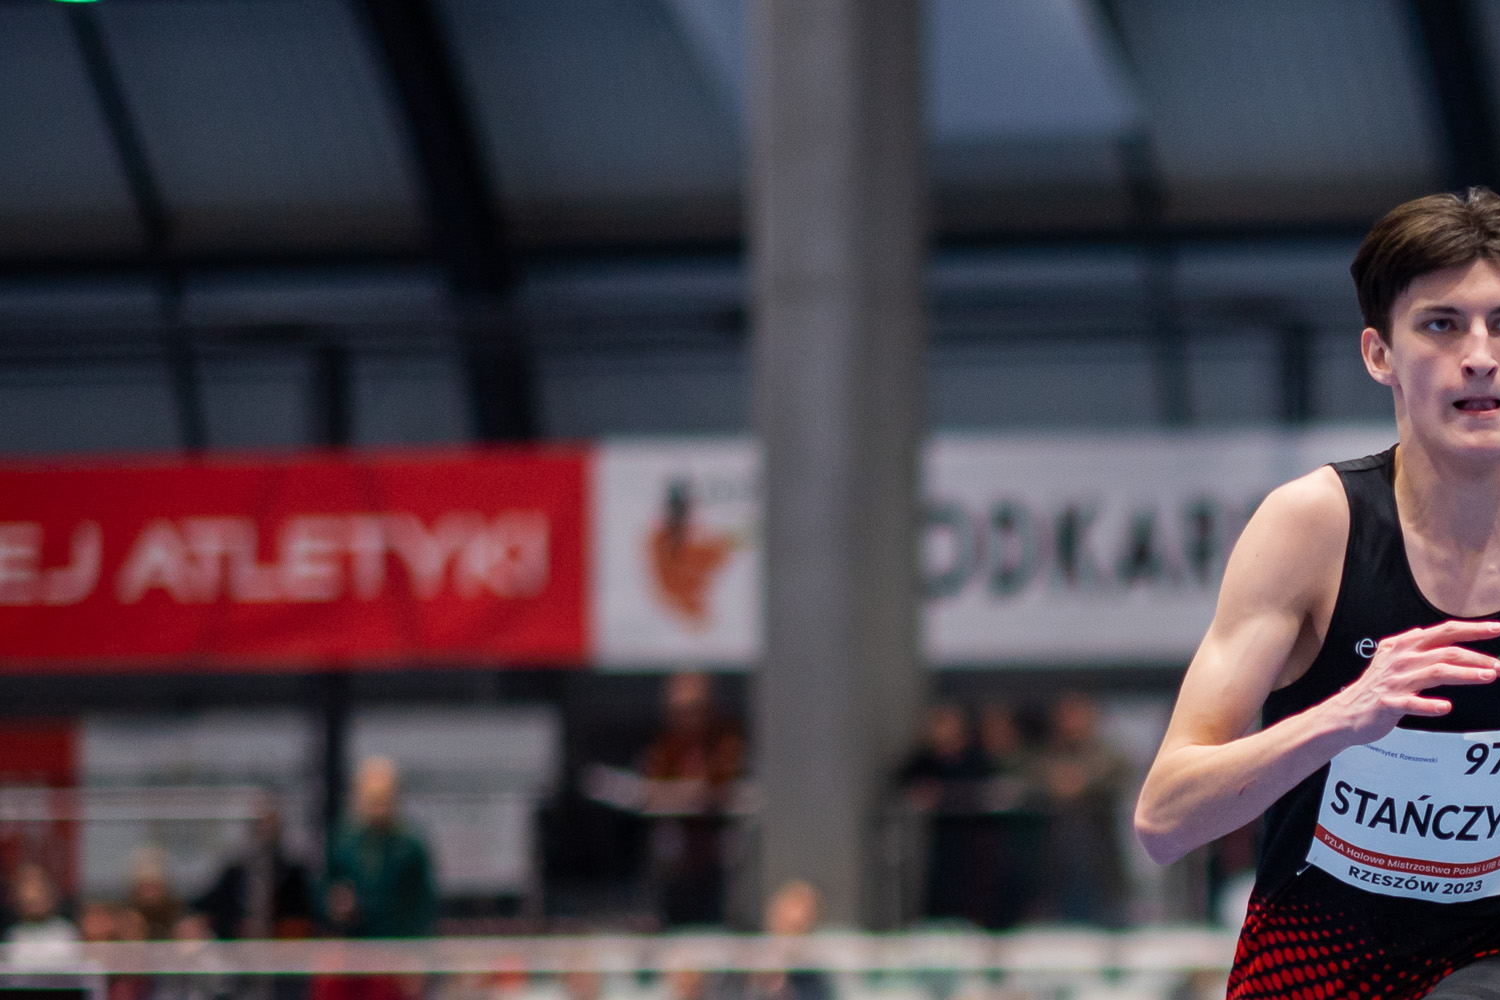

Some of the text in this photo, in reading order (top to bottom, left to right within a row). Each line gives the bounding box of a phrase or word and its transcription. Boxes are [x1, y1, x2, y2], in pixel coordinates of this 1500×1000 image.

[114, 510, 552, 606] ATLETYKI
[1324, 834, 1344, 852] PZLA
[1346, 847, 1385, 865] Halowe
[1387, 859, 1451, 876] Mistrzostwa
[1452, 865, 1481, 876] Polski
[1482, 860, 1497, 872] U18
[1348, 865, 1483, 895] RZESZÓW 2023
